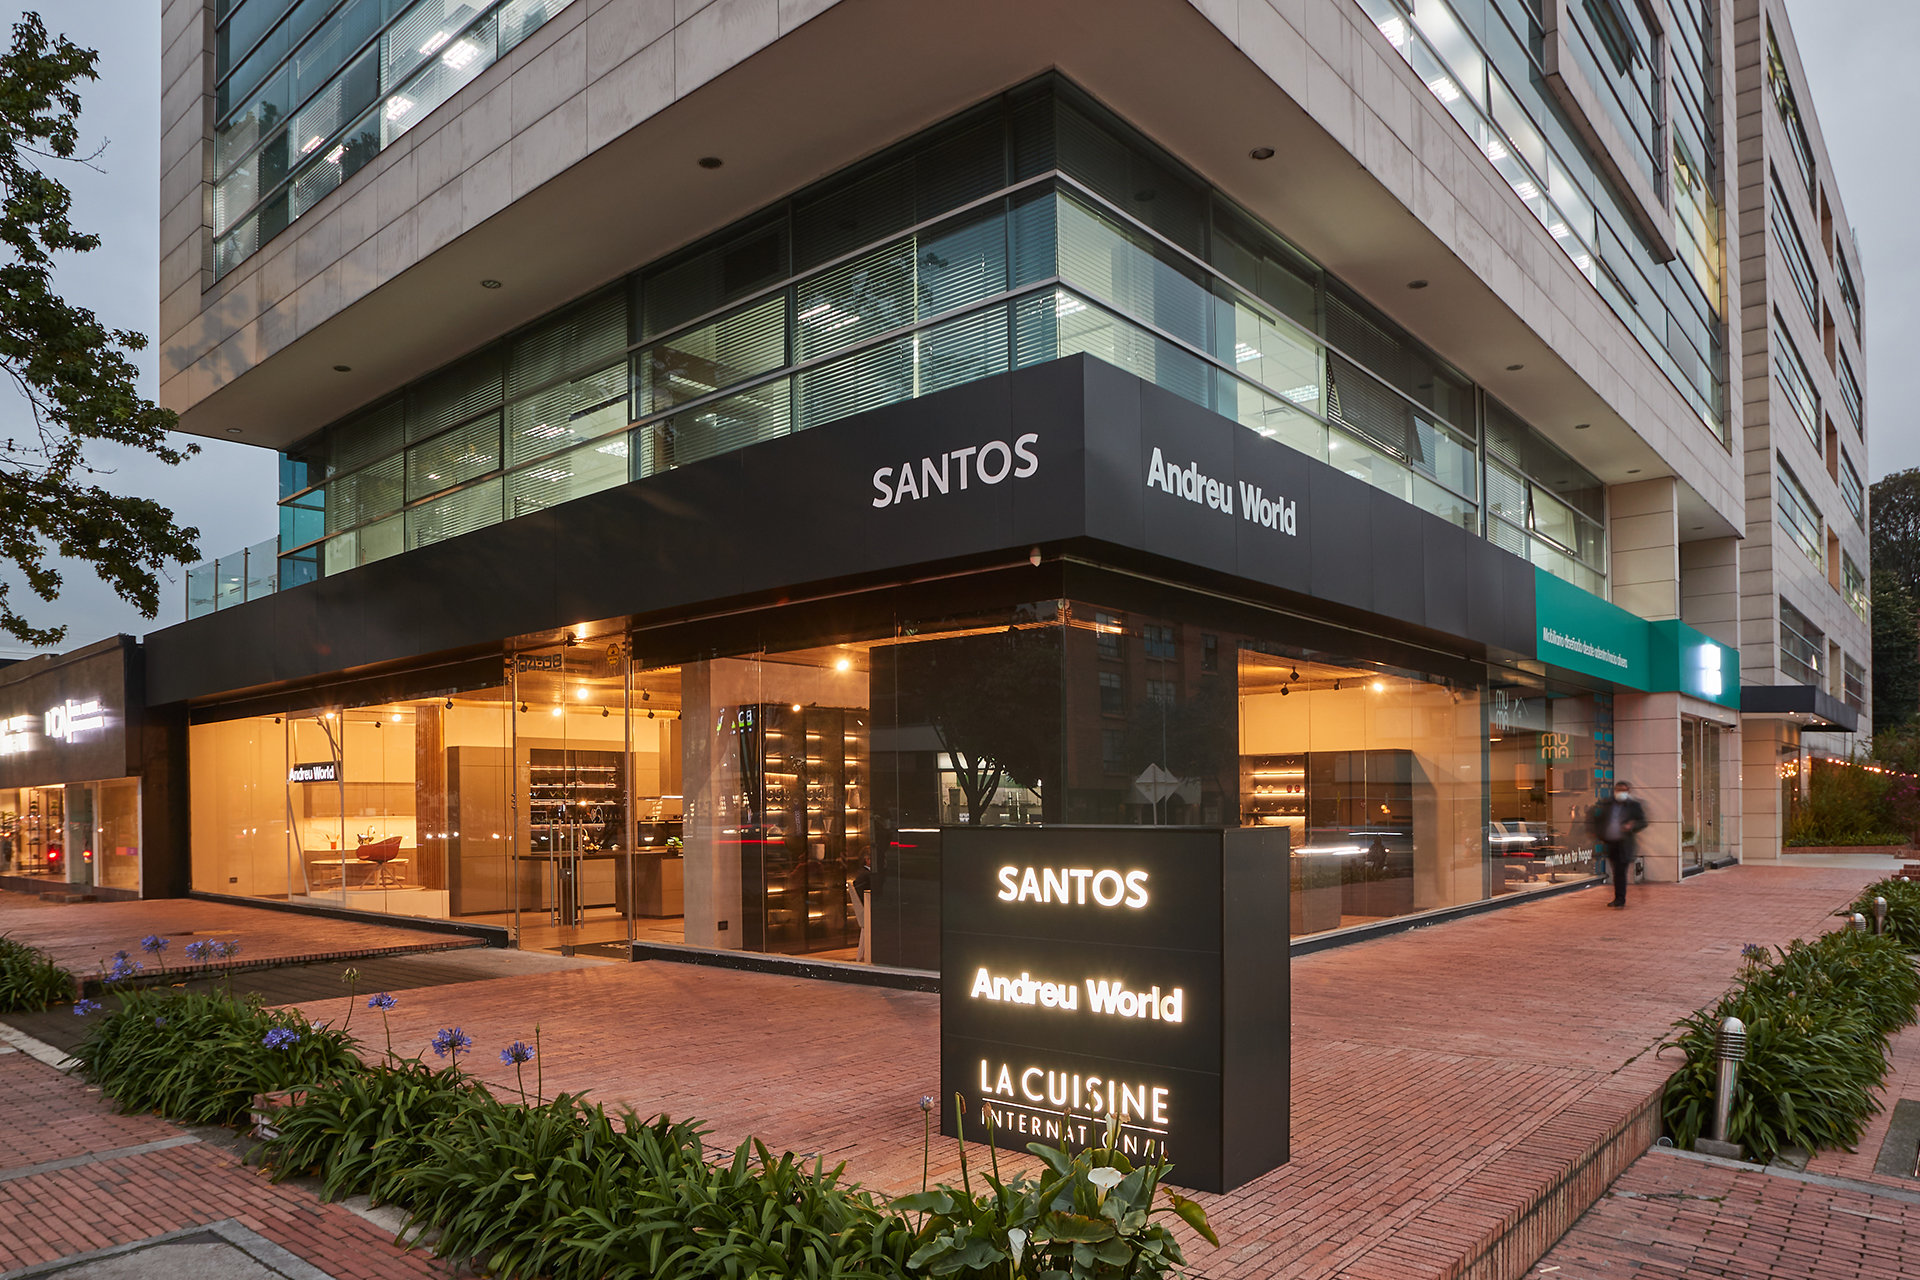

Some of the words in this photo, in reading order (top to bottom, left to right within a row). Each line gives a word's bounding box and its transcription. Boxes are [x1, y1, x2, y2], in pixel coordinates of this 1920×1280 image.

[872, 433, 1039, 508] SANTOS
[1147, 447, 1233, 515] Andreu
[1239, 481, 1297, 537] World
[1543, 627, 1564, 647] Mobiliario
[289, 767, 313, 781] Andreu
[313, 765, 335, 780] World
[1578, 847, 1592, 865] hogar
[997, 866, 1149, 909] SANTOS
[970, 968, 1077, 1010] Andreu
[1086, 979, 1183, 1023] World
[981, 1108, 1169, 1162] INTERNATONAL
